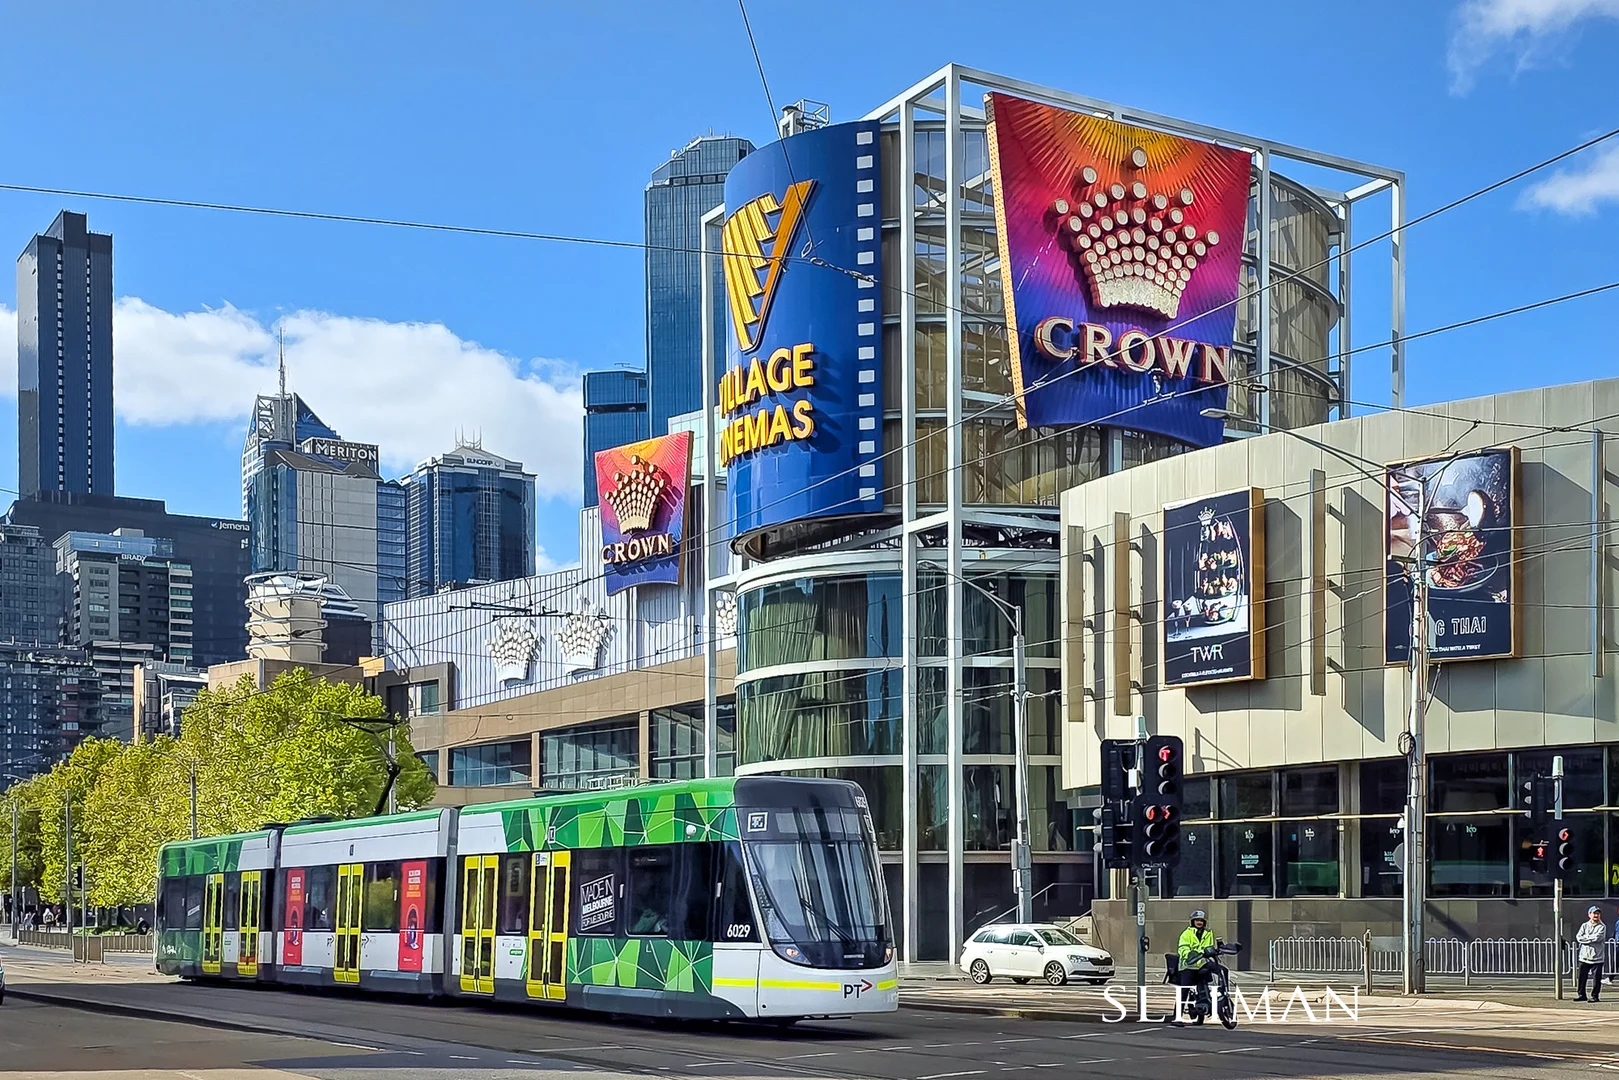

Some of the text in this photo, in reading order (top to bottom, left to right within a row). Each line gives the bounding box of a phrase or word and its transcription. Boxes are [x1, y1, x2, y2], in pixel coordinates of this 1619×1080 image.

[1034, 316, 1231, 383] CROWN
[719, 343, 814, 417] VILLAGE
[315, 442, 377, 461] MERITON
[219, 521, 250, 531] Jemena
[121, 553, 147, 561] BRADY
[601, 533, 672, 564] CROWN
[1451, 616, 1487, 635] THAI
[1190, 644, 1224, 663] TWR
[726, 923, 751, 938] 6029
